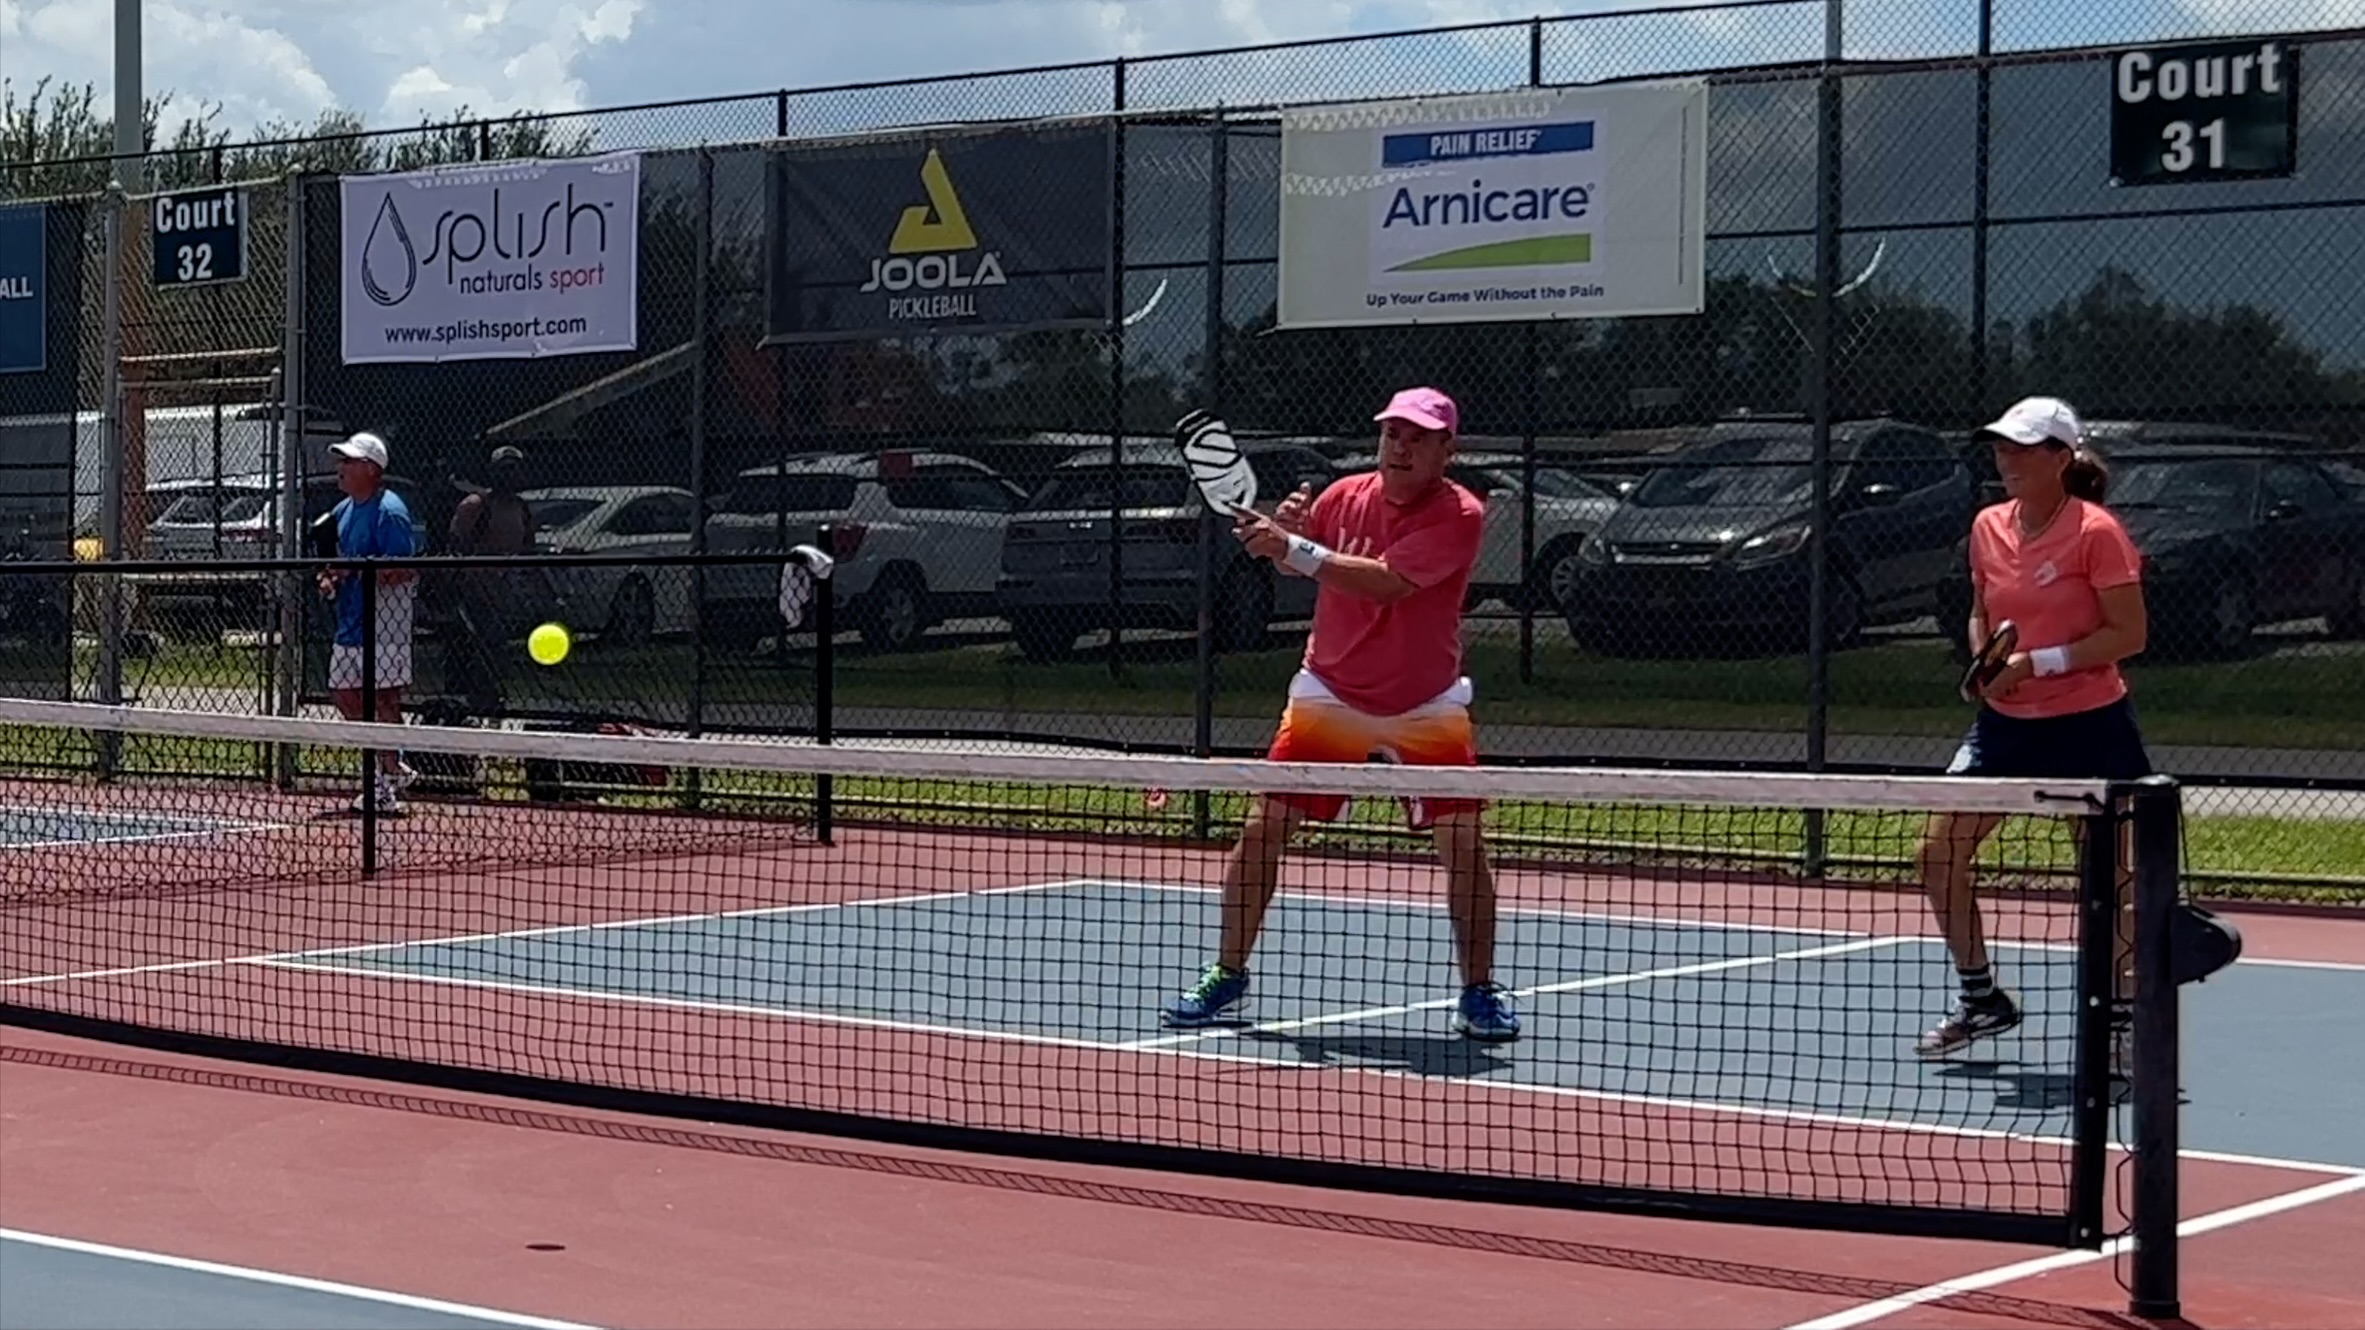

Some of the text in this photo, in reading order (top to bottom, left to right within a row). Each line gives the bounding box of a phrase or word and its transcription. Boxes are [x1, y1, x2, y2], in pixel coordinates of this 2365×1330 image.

[2118, 43, 2282, 103] Court
[1430, 129, 1538, 156] PAIN RELIEF
[2161, 117, 2226, 172] 31
[156, 191, 235, 233] Court
[422, 183, 606, 285] splish
[178, 243, 213, 281] 32
[460, 262, 604, 294] naturals sport
[860, 252, 1007, 293] JOOLA
[889, 294, 977, 319] PICKLEBALL
[1366, 283, 1604, 308] Up Your Game Without the Pain
[385, 317, 587, 345] www.splishsport.com
